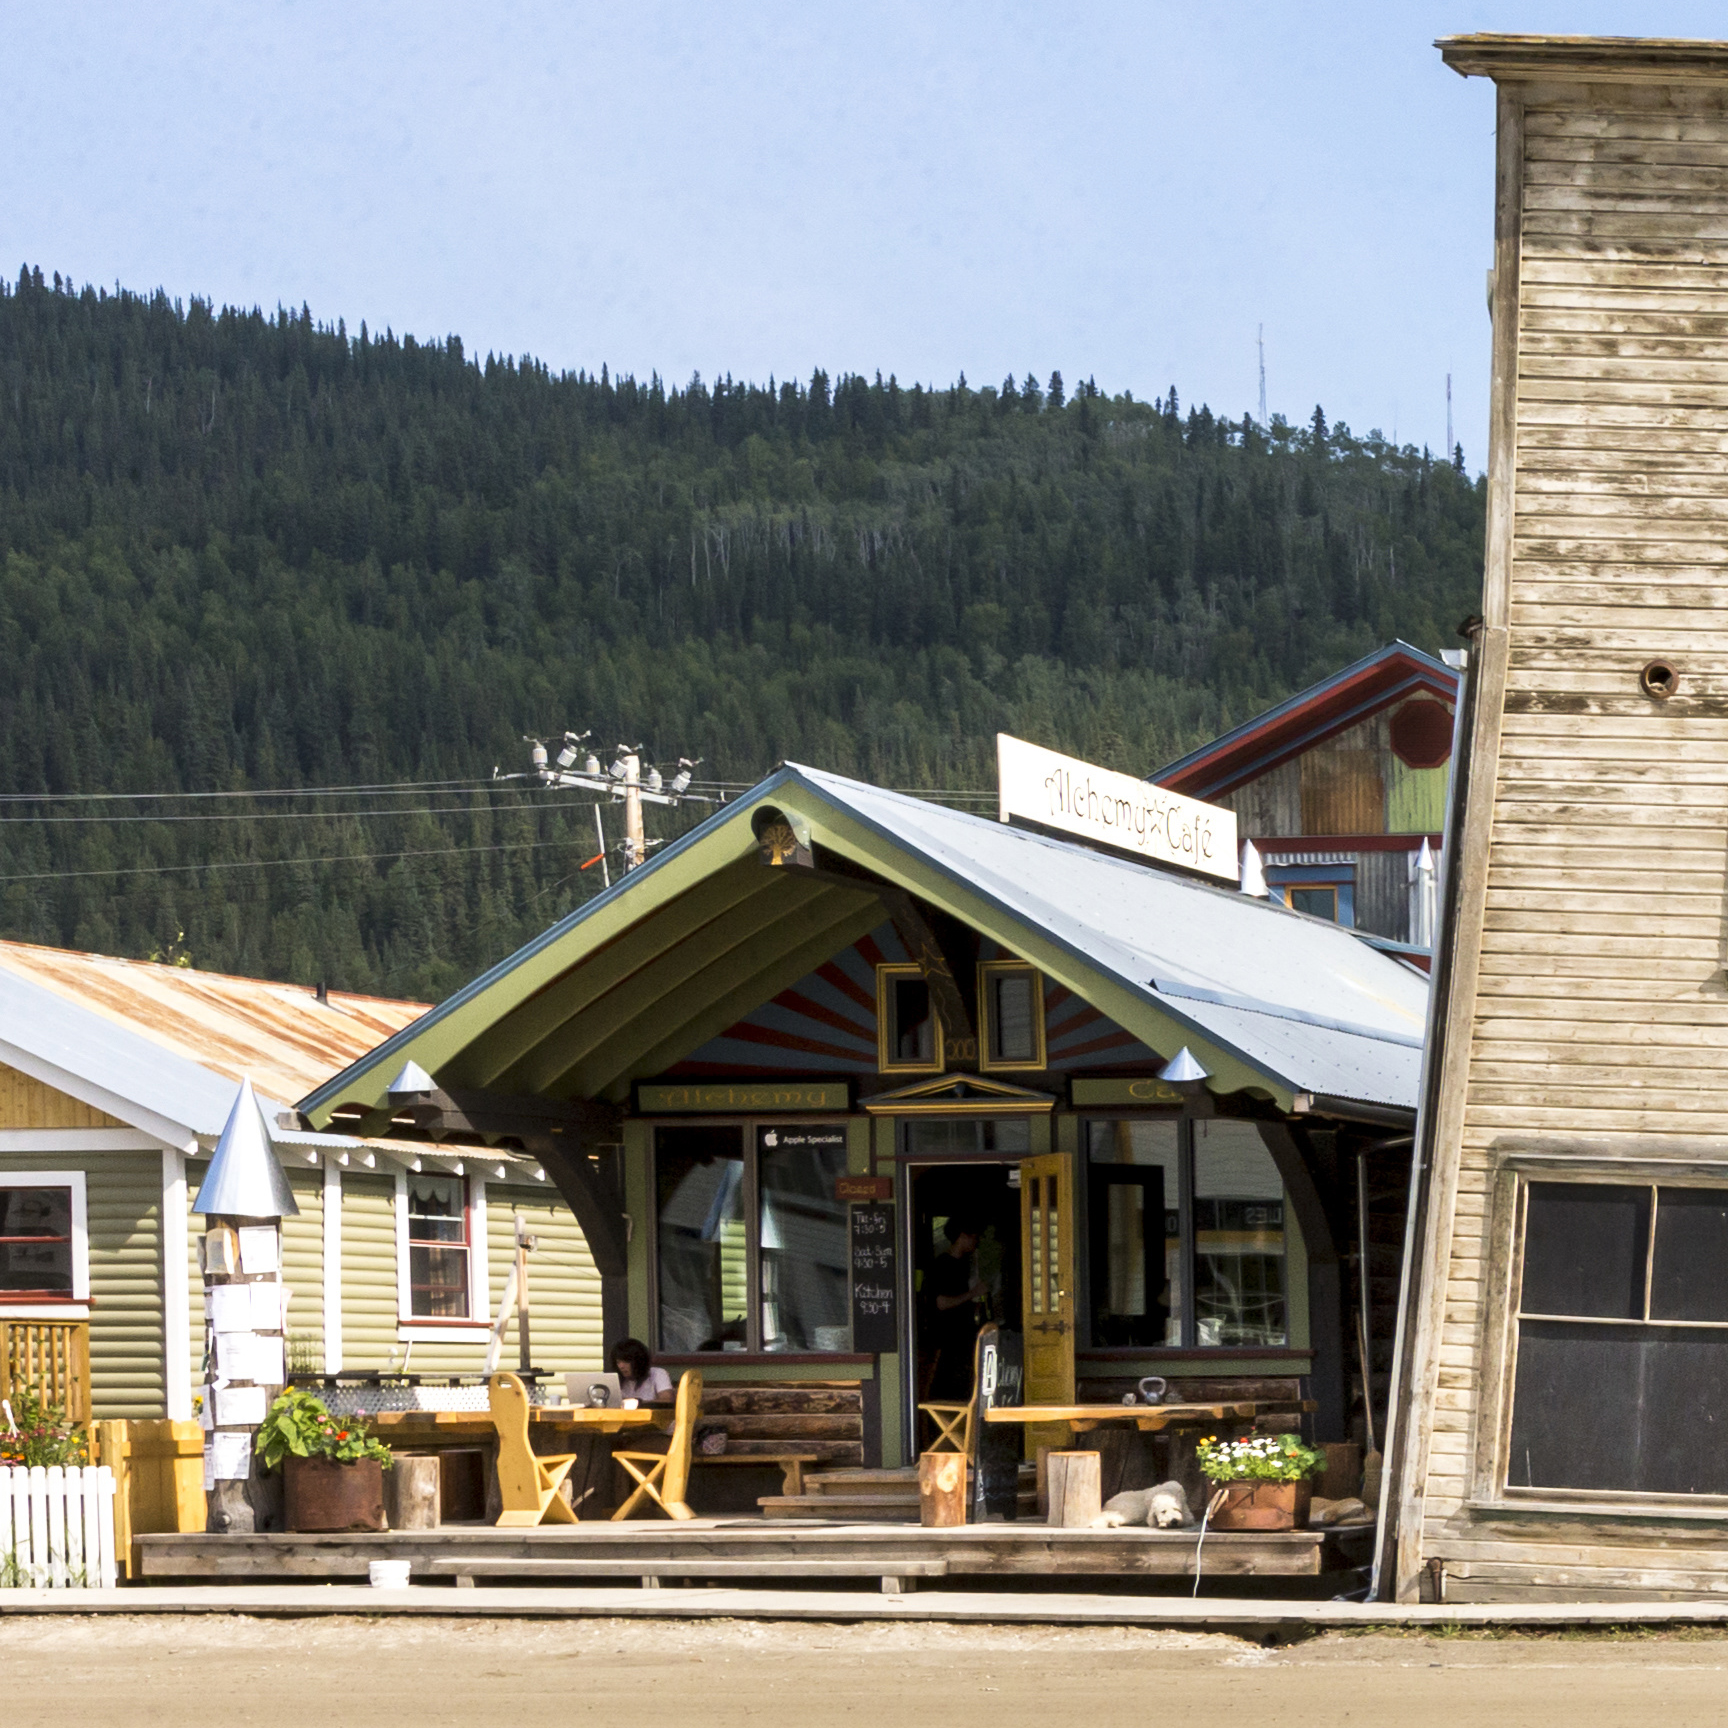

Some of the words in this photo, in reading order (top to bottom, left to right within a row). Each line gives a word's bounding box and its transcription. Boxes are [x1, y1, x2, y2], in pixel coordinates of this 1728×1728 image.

[1045, 768, 1147, 846] Alchemy
[1167, 806, 1213, 865] Café
[659, 1088, 826, 1108] Alchemy
[782, 1136, 805, 1145] Apple
[807, 1135, 843, 1145] Specialist
[854, 1283, 894, 1299] Kitchen
